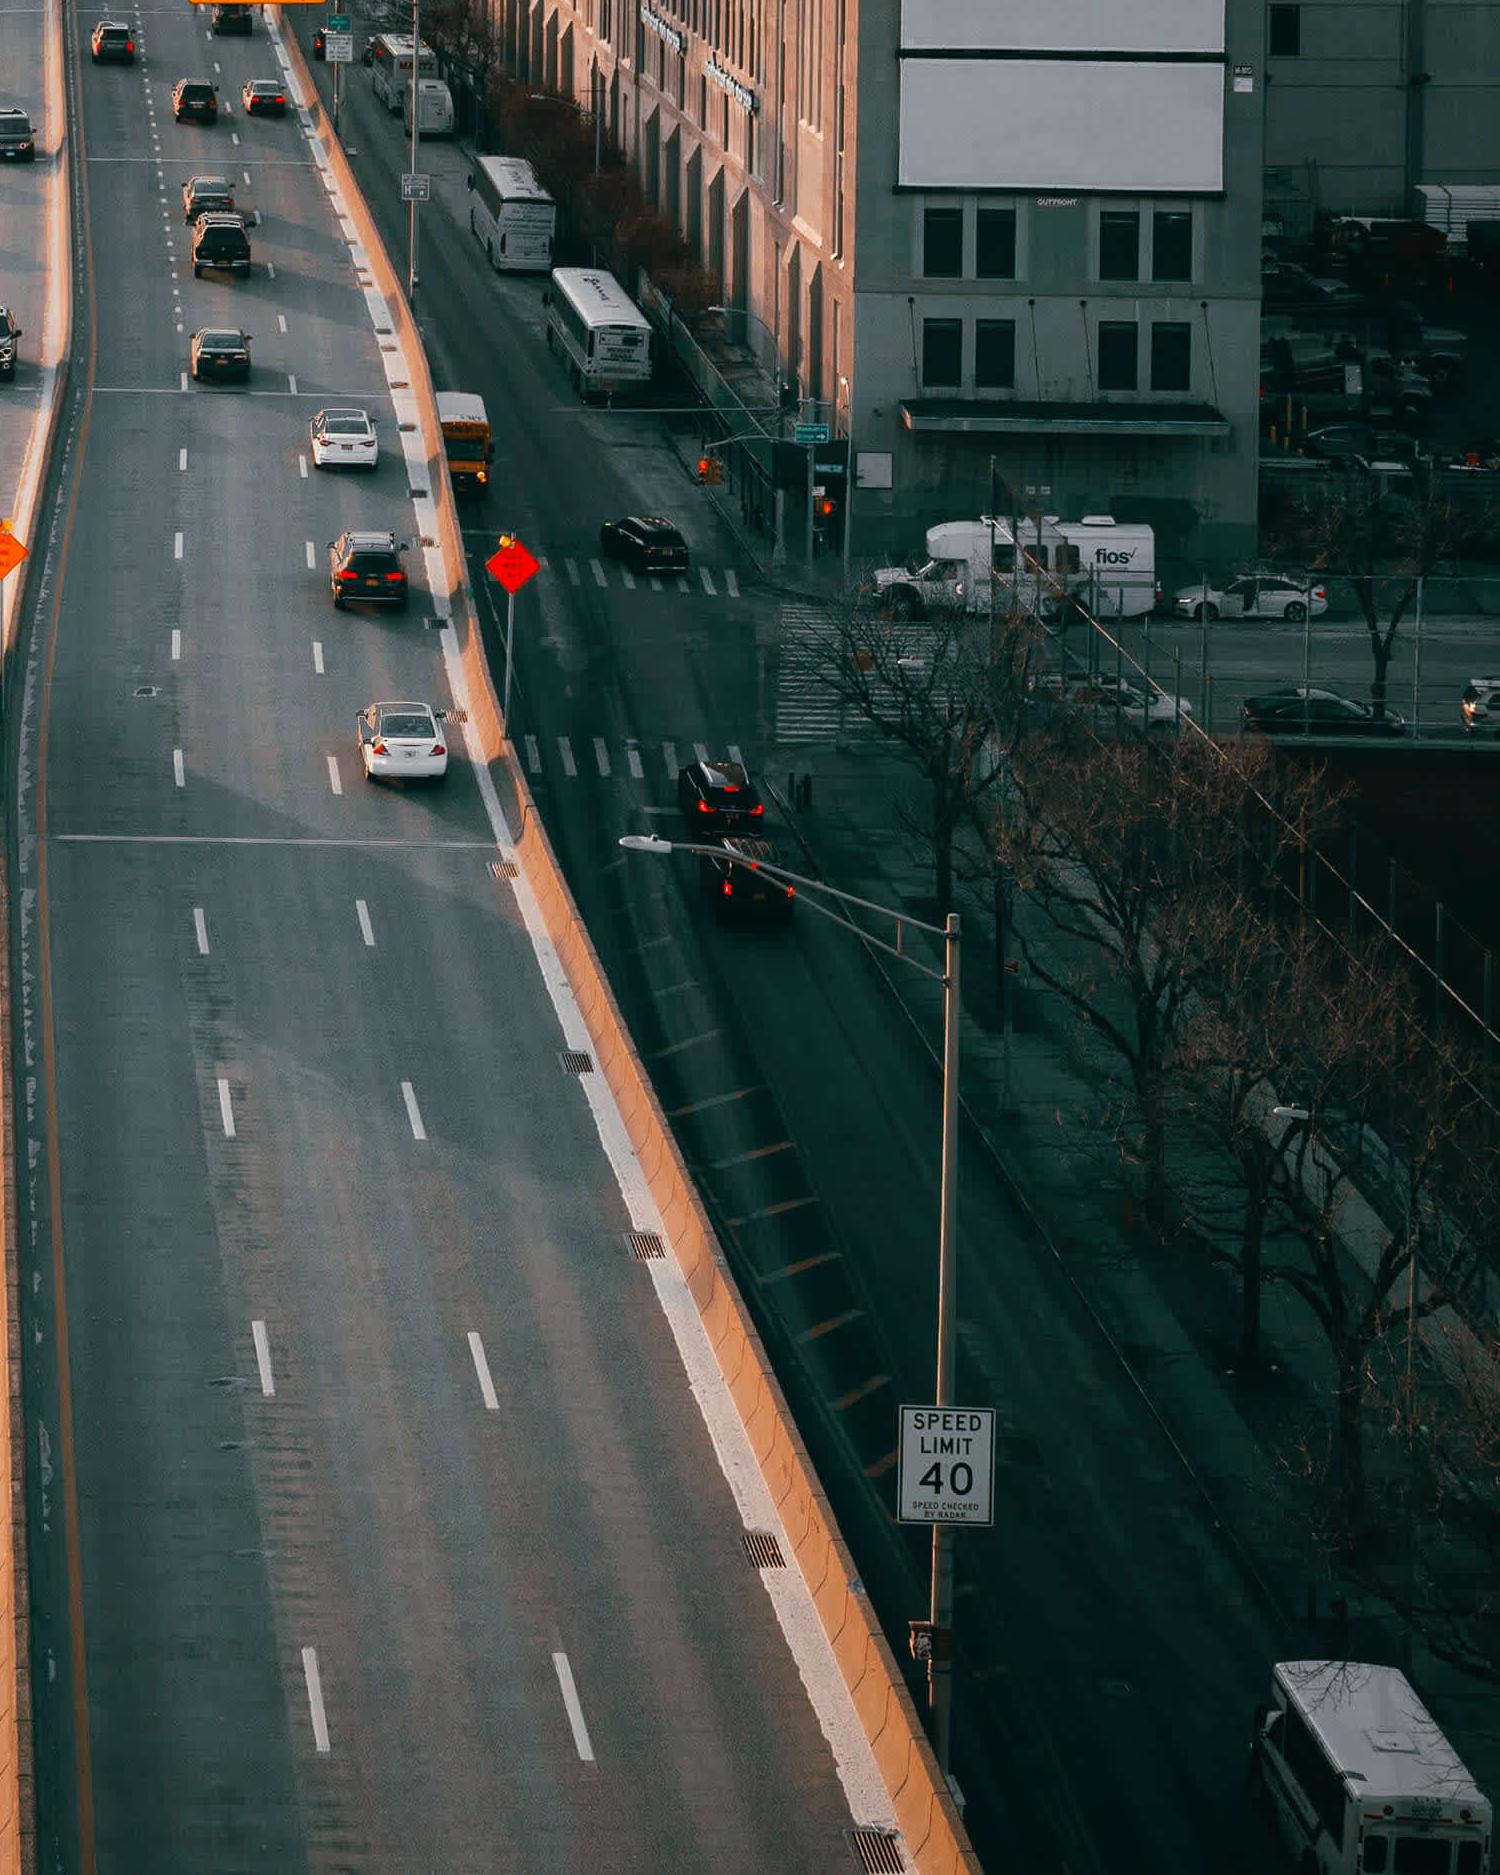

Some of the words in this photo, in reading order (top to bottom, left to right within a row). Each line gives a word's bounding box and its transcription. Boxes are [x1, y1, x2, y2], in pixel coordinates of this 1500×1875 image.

[1095, 548, 1130, 564] fios
[913, 1412, 982, 1432] SPEED
[920, 1436, 973, 1456] LIMIT
[919, 1462, 973, 1496] 40
[912, 1500, 939, 1510] SPEED
[941, 1501, 980, 1511] CHECKED
[924, 1510, 934, 1518] BY
[938, 1510, 966, 1519] RADAR
